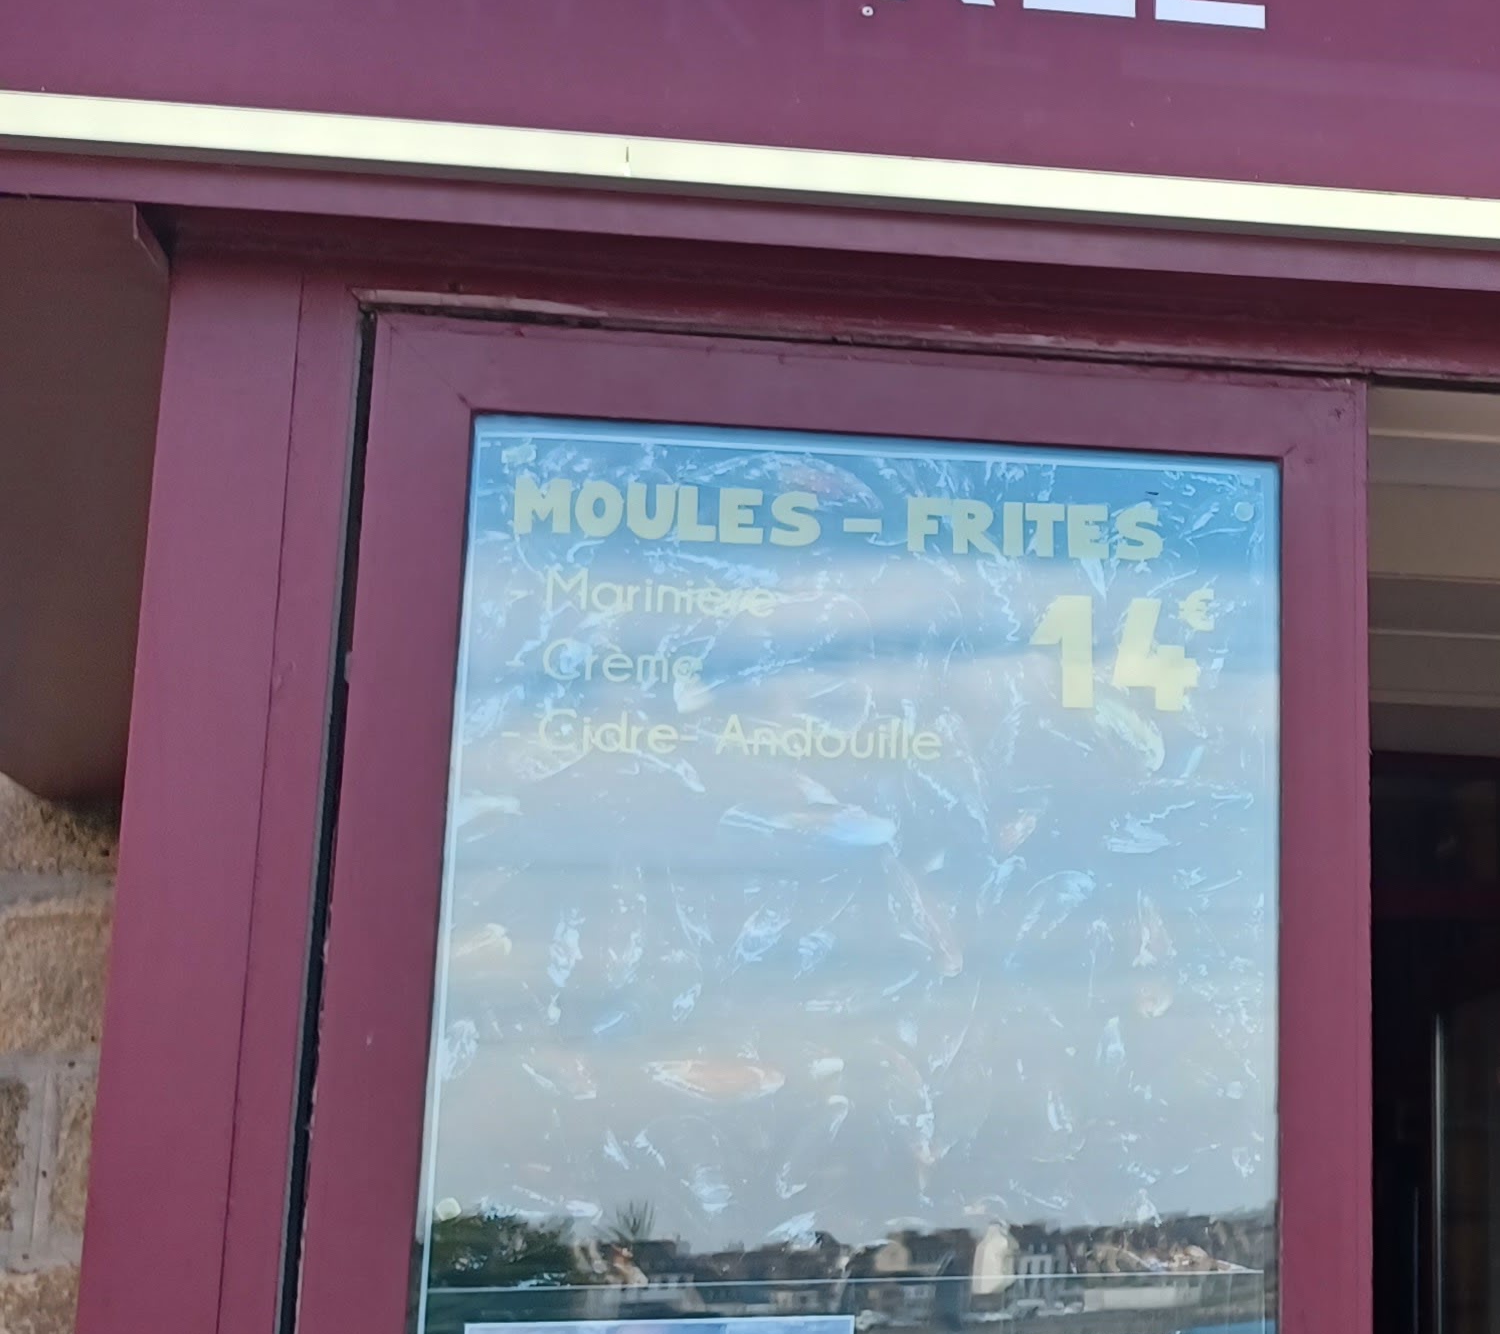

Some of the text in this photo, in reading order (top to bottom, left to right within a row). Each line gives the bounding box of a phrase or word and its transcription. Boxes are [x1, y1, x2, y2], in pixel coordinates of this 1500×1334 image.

[513, 474, 822, 547] MOULES
[906, 496, 1164, 562] FRITES
[545, 566, 778, 618] Marinière
[715, 713, 943, 760] Andouille
